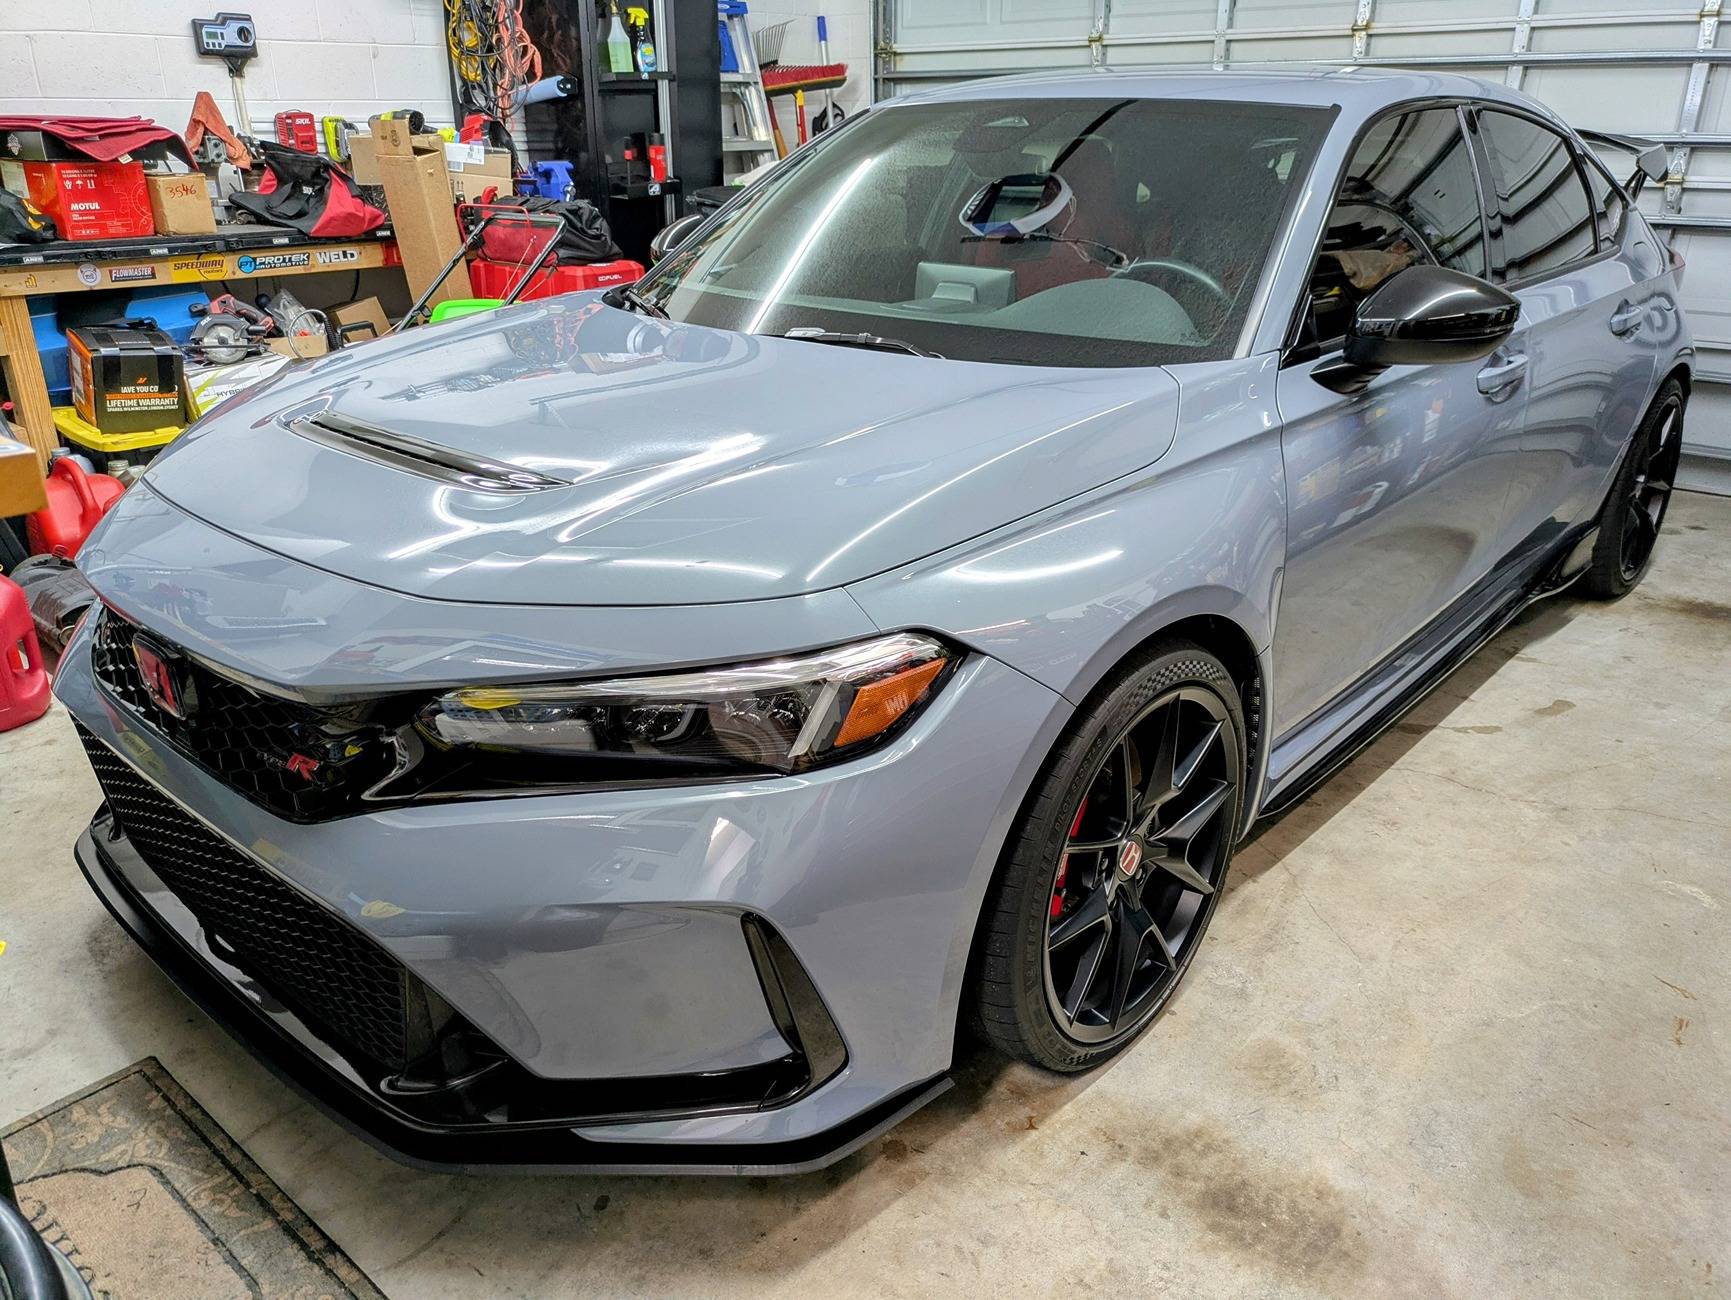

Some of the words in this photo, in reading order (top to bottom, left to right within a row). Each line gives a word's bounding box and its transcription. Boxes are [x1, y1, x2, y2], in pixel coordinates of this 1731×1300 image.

[165, 184, 197, 198] 3546
[71, 202, 100, 210] MOTUL
[256, 253, 309, 265] PROTEK
[316, 250, 358, 264] WELD
[173, 259, 224, 271] SPEEDWAY
[111, 267, 152, 281] FLOWMASTER
[136, 385, 149, 393] YOU
[106, 399, 138, 408] LIFETIME
[139, 397, 178, 406] WARRANTY
